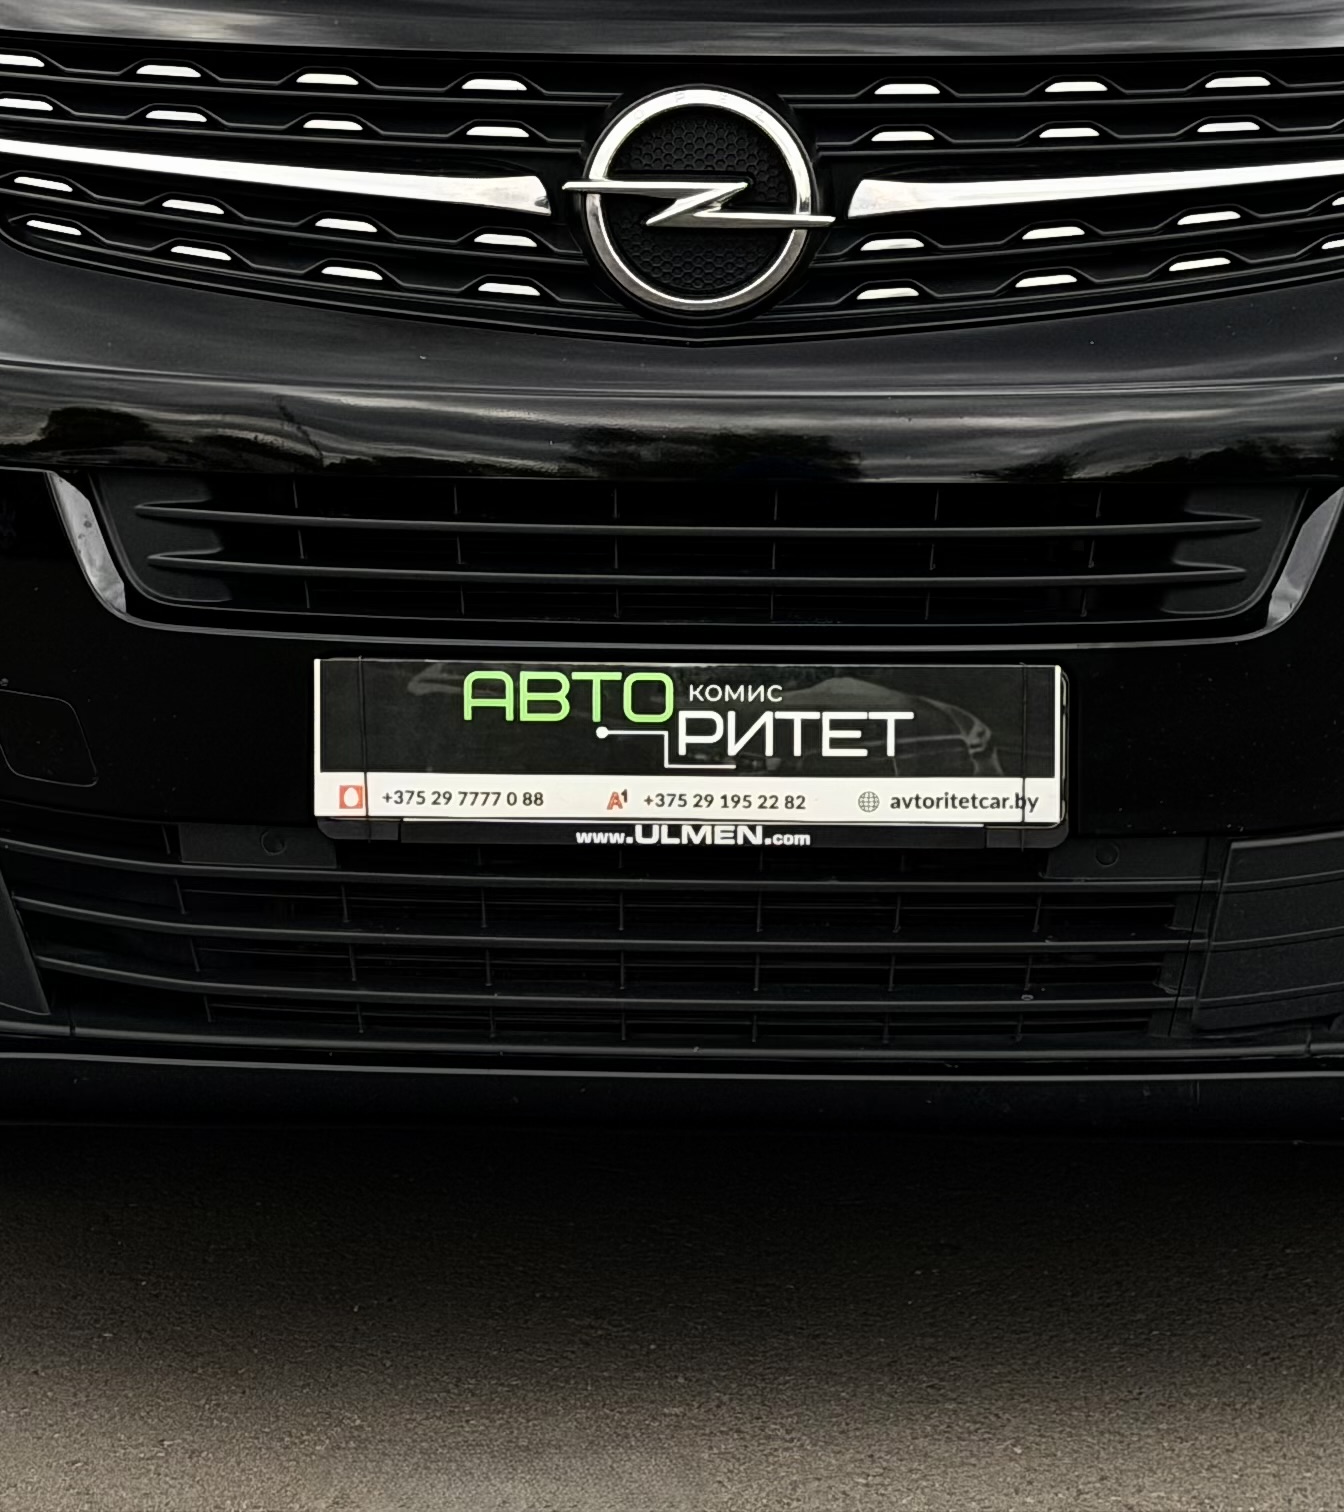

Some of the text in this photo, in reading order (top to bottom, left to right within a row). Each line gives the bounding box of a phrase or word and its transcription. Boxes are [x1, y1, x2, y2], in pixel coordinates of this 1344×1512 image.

[463, 670, 674, 722] АВТО
[689, 684, 783, 702] КОМИС
[678, 710, 915, 756] РИТЕТ
[382, 790, 544, 806] +375 29 7777 0 88
[644, 793, 806, 809] +375 29 195 22 82
[890, 792, 1039, 813] avtoritetcar.by
[575, 824, 811, 846] www.ULMEN.com
